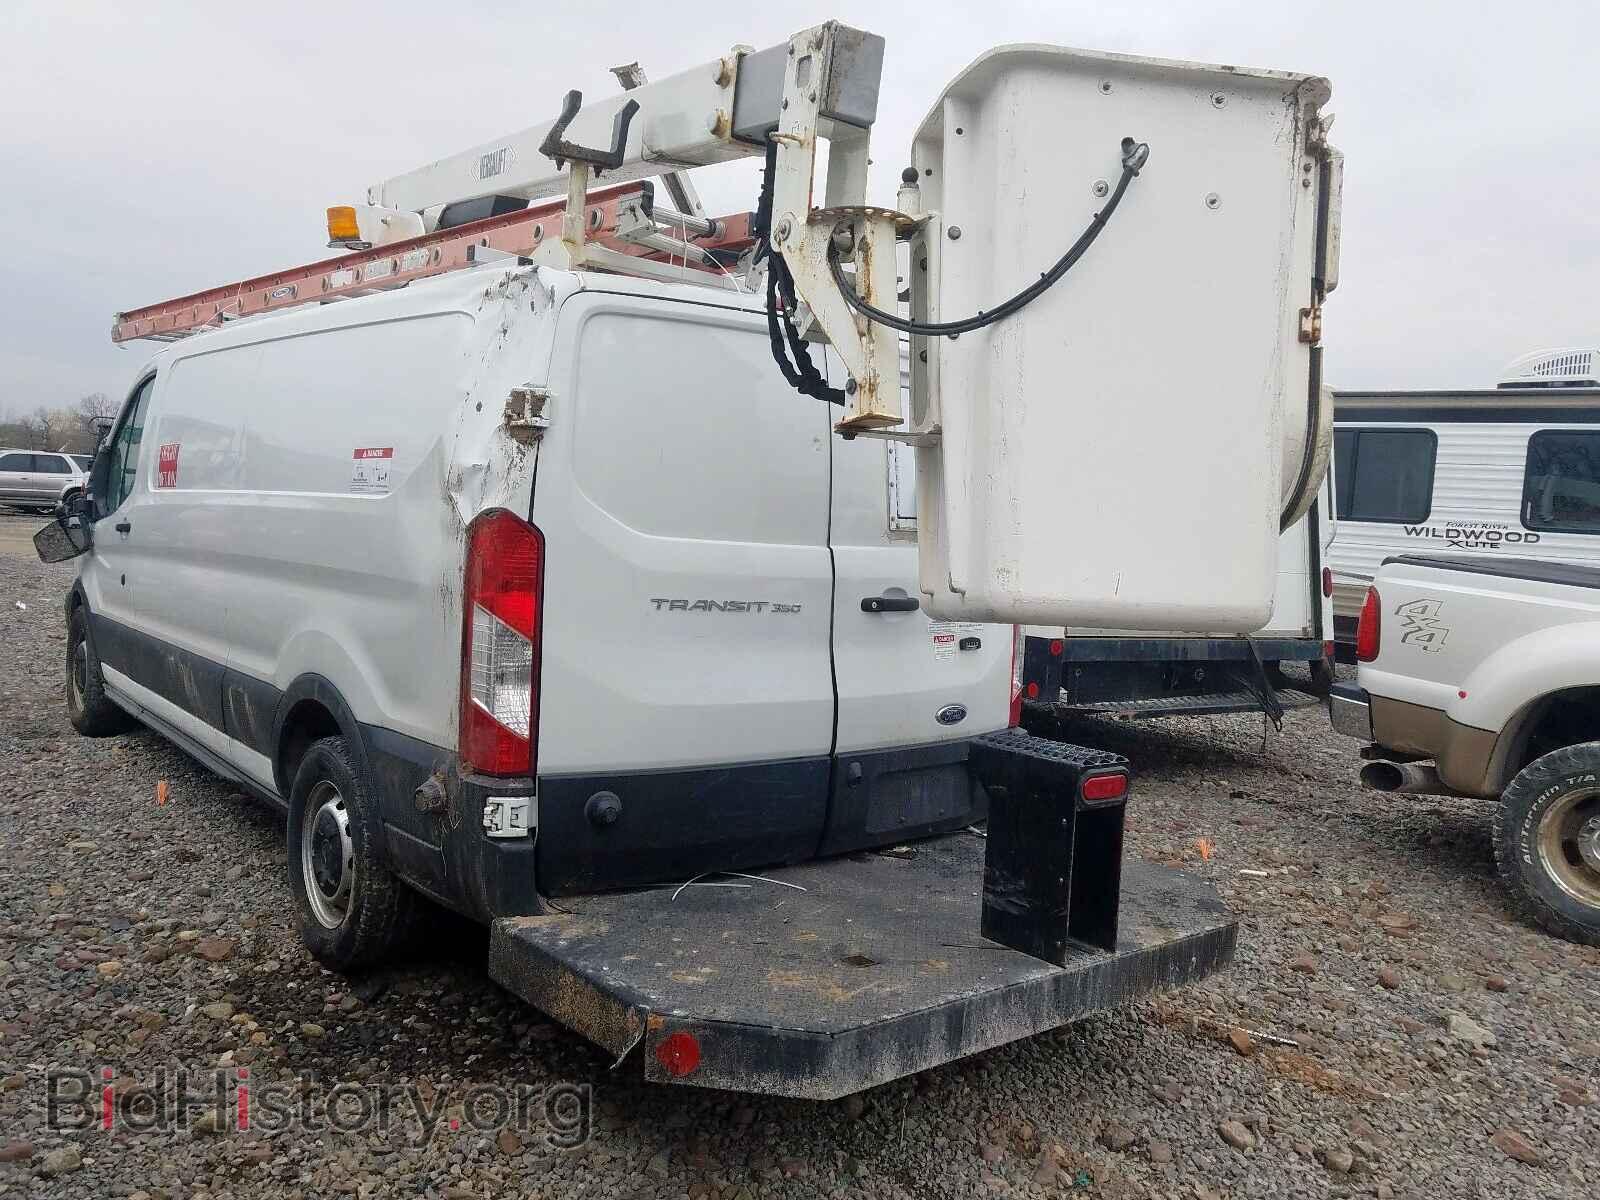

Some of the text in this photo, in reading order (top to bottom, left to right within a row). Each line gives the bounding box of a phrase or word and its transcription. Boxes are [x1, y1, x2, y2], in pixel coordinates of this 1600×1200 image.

[1446, 521, 1478, 529] FOREST
[1403, 525, 1541, 544] WILDWOOD
[650, 598, 801, 614] TRANSIT 350
